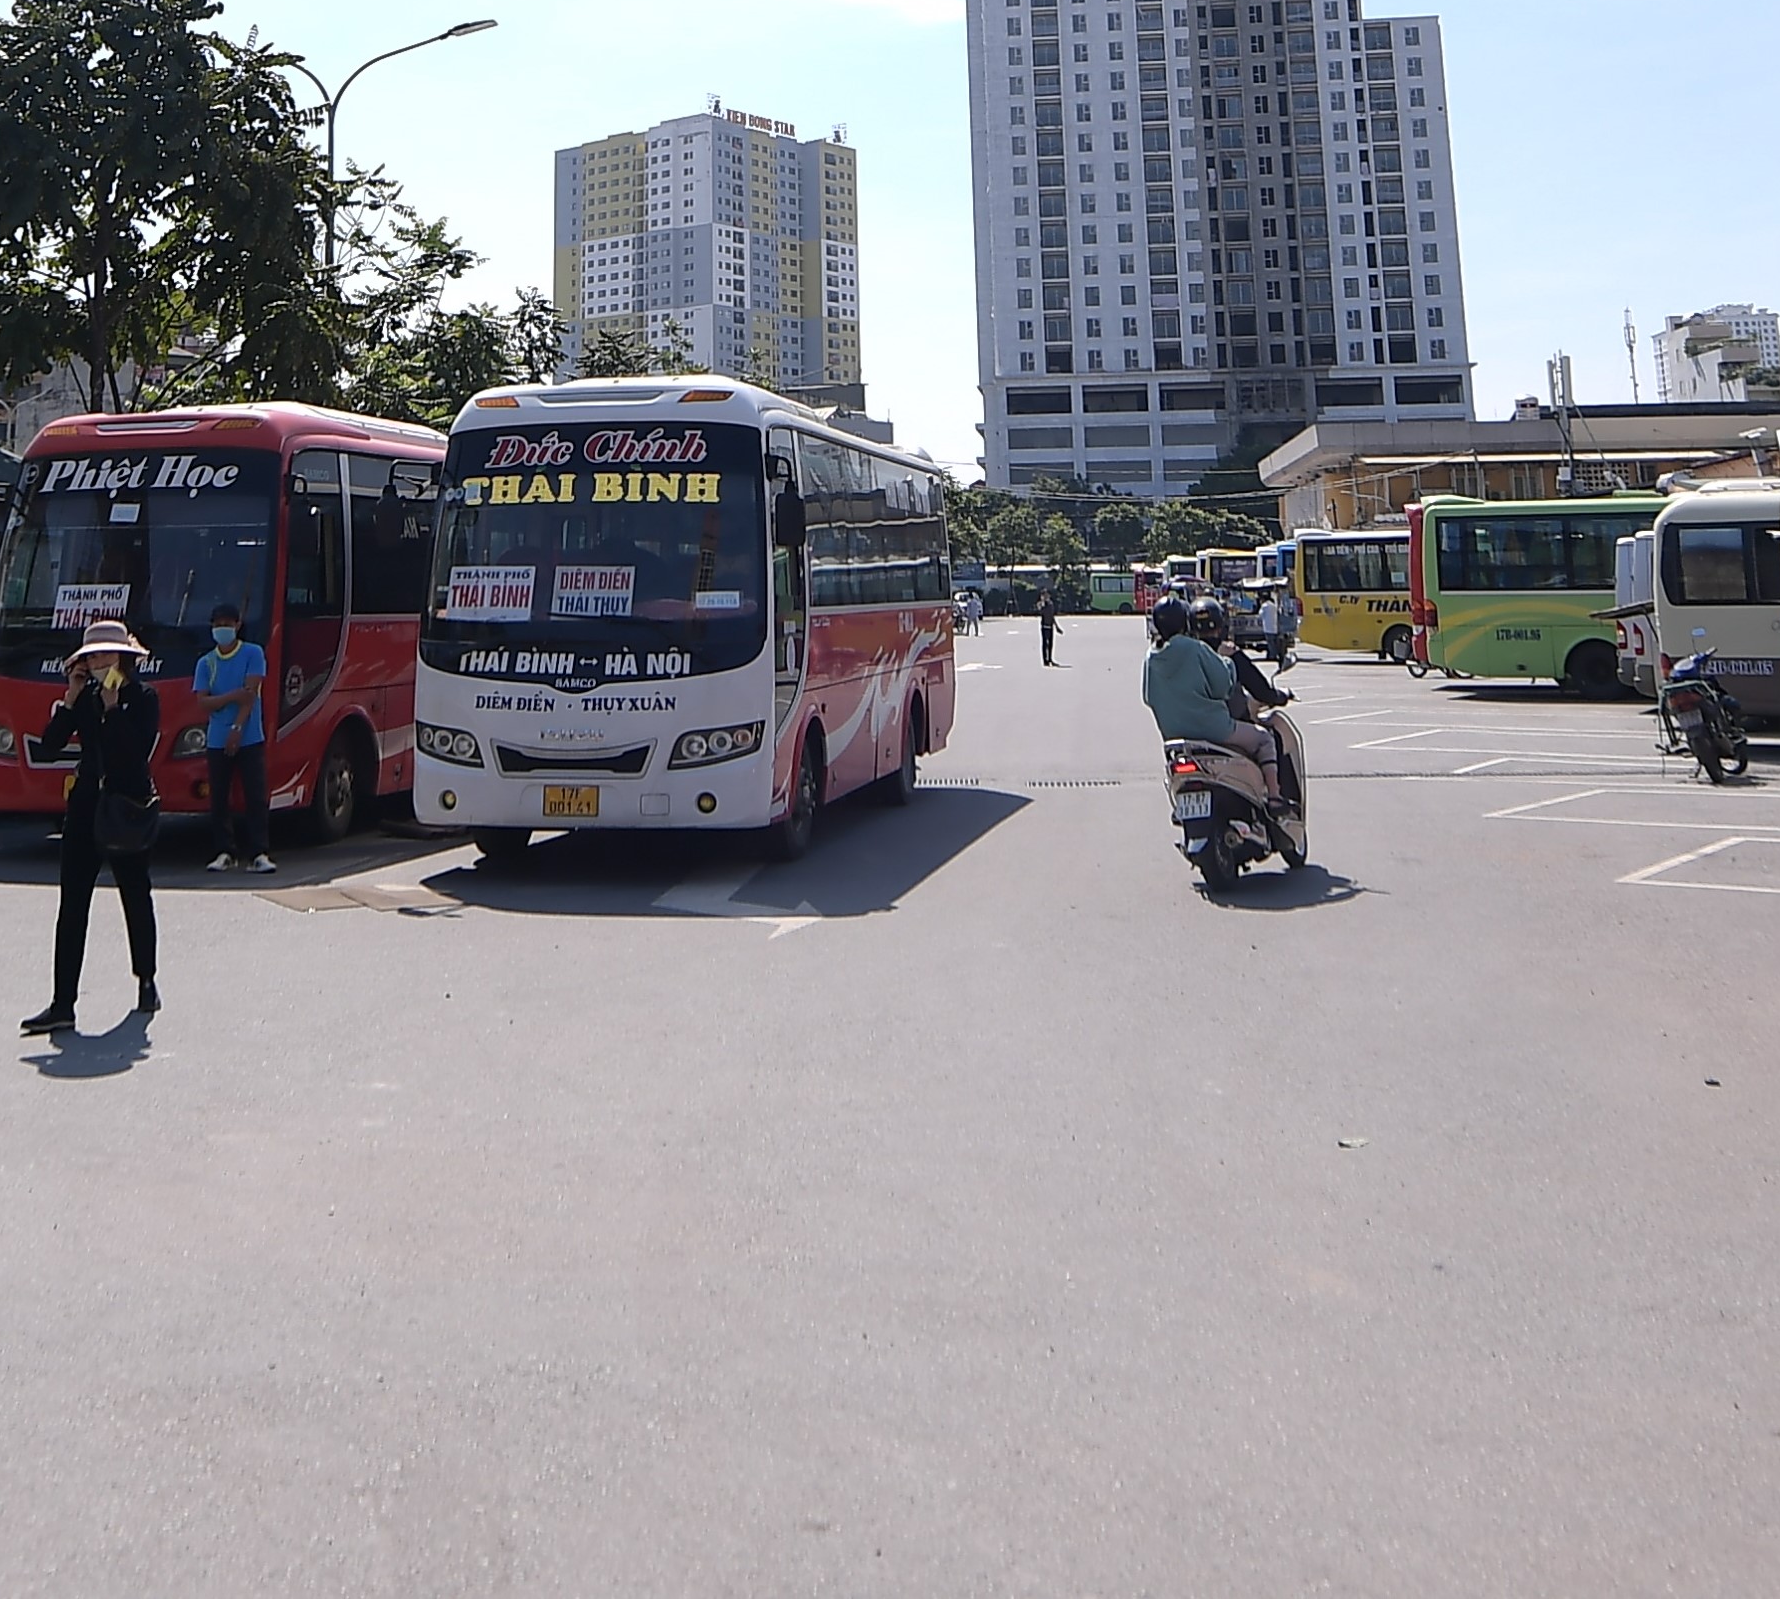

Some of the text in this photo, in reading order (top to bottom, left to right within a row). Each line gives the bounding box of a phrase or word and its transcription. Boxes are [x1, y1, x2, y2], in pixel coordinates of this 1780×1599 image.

[485, 428, 708, 469] Đức Chính
[38, 455, 239, 499] Phiệt Học
[462, 464, 721, 506] THÁI BÌNH
[560, 568, 595, 590] DIÊM
[62, 585, 126, 601] THÀNH PHỐ
[451, 580, 531, 608] THÁI BÌNH
[558, 593, 591, 613] THÁI
[55, 603, 87, 629] THÁI
[515, 647, 575, 675] BÌNH
[605, 646, 638, 675] HÀ
[646, 647, 691, 679] NỘI
[475, 691, 513, 710] DIÊM
